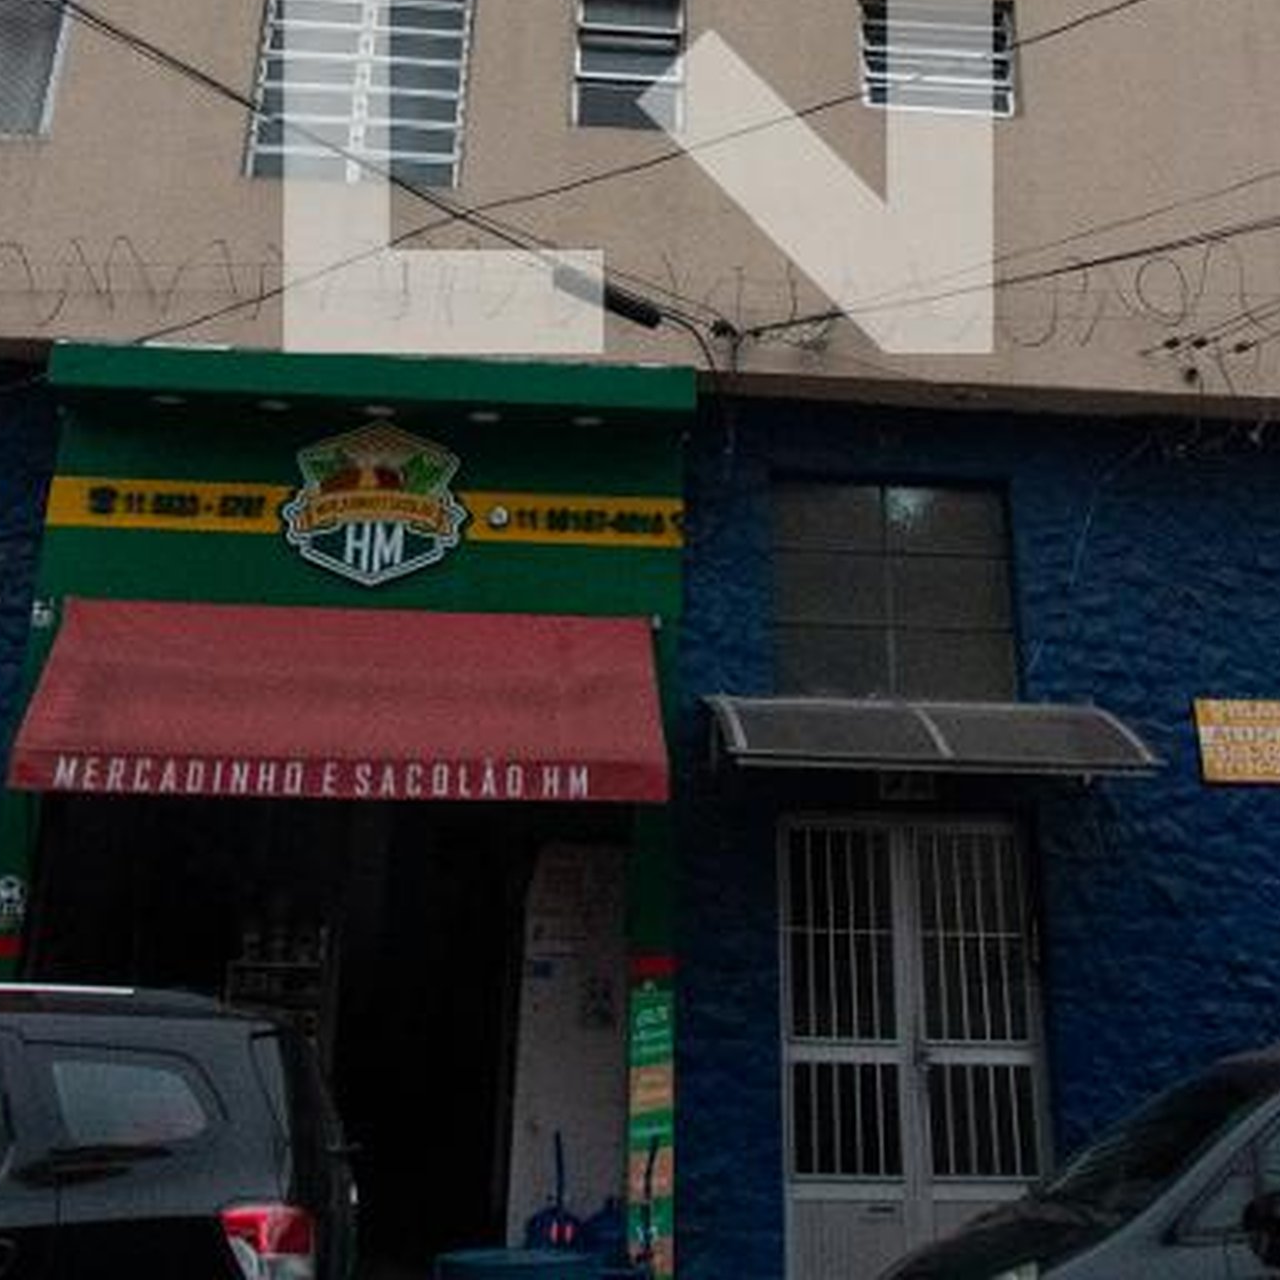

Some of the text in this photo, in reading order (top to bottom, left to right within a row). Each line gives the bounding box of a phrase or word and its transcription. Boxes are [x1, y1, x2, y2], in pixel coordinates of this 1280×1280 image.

[344, 521, 404, 572] HM
[52, 754, 589, 797] MERCADINHO E SACOLÃO HM
